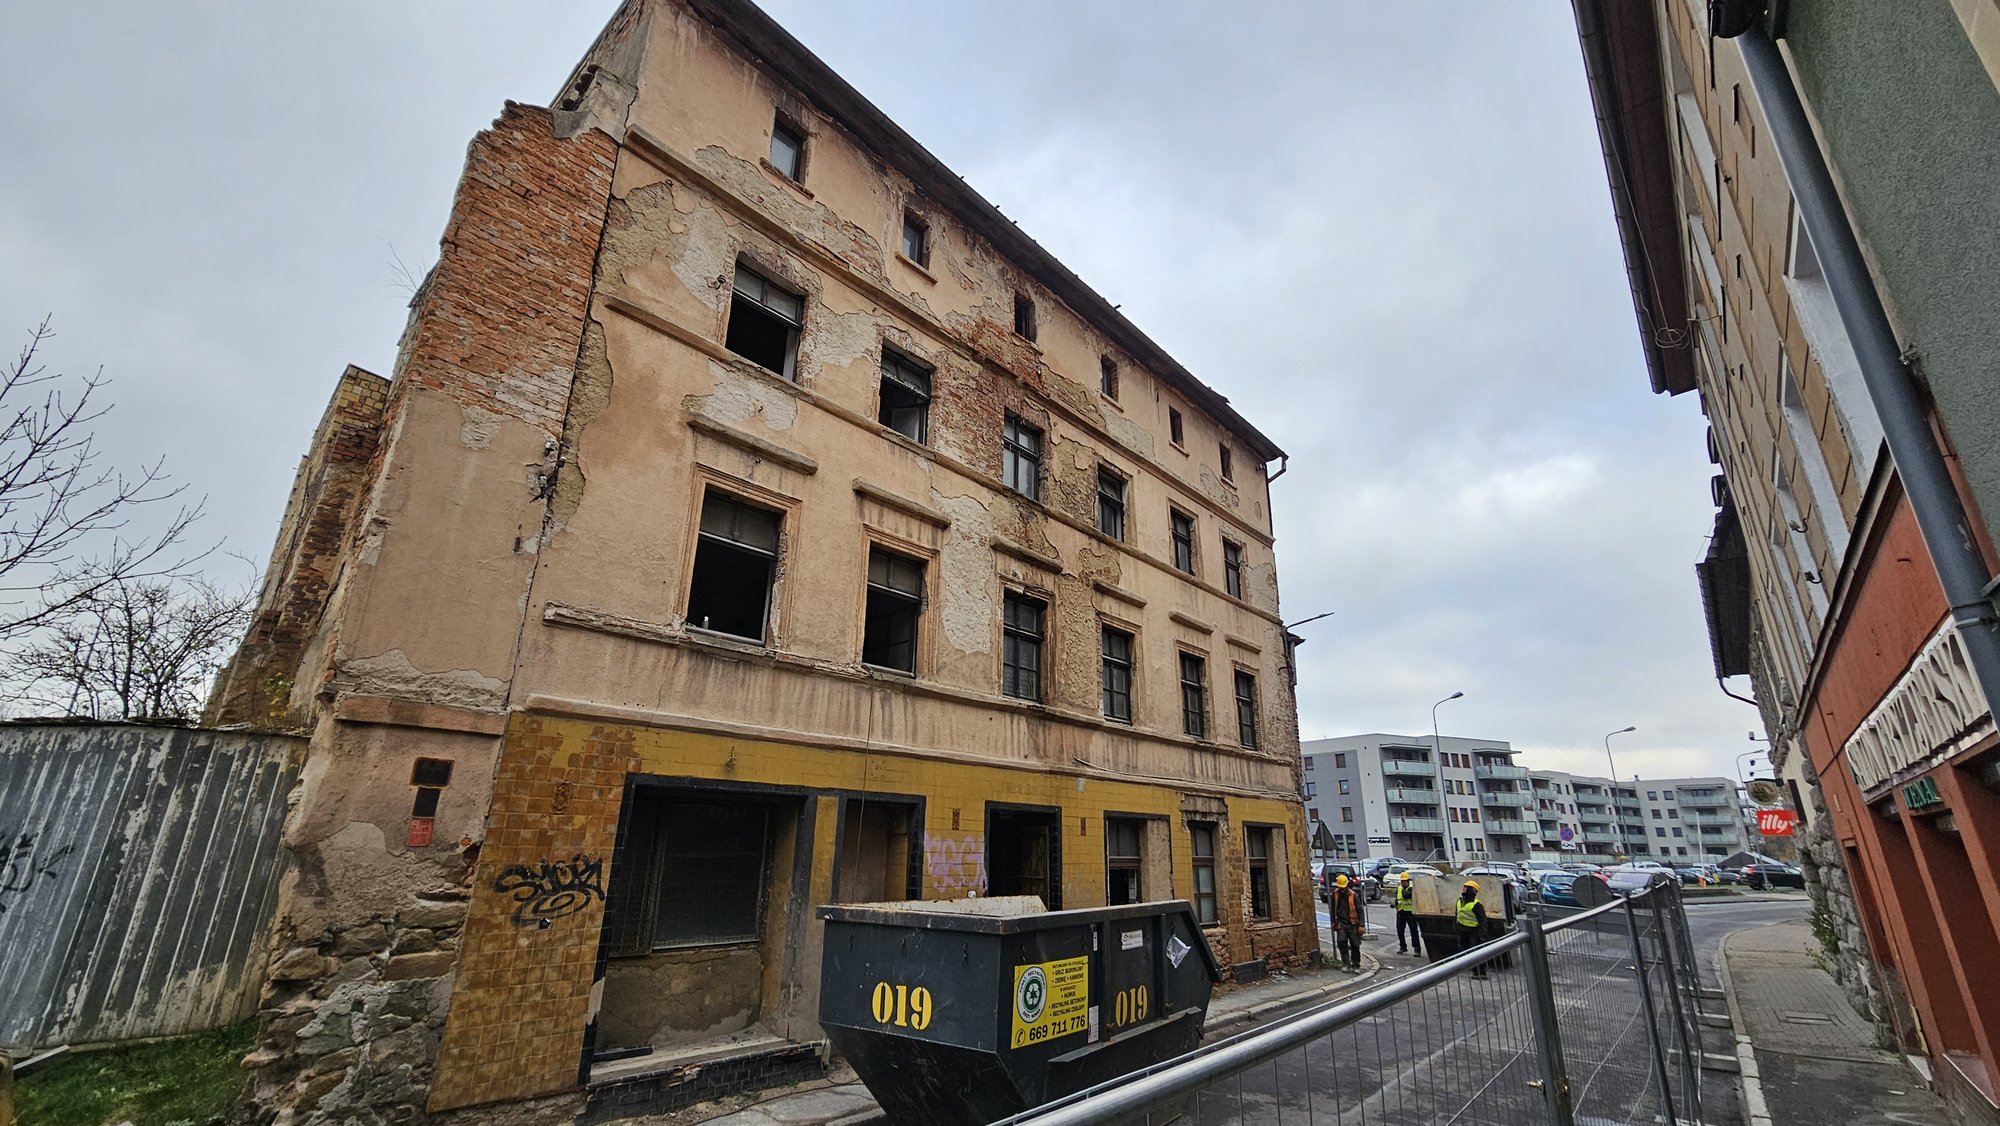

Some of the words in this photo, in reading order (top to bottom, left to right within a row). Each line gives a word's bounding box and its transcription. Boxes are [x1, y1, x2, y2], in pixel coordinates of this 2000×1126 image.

[1761, 814, 1788, 833] illy
[872, 981, 932, 1030] 019
[1115, 985, 1148, 1028] 019
[1029, 1024, 1048, 1041] 669
[1051, 1019, 1068, 1036] 711
[1070, 1014, 1086, 1030] 776
